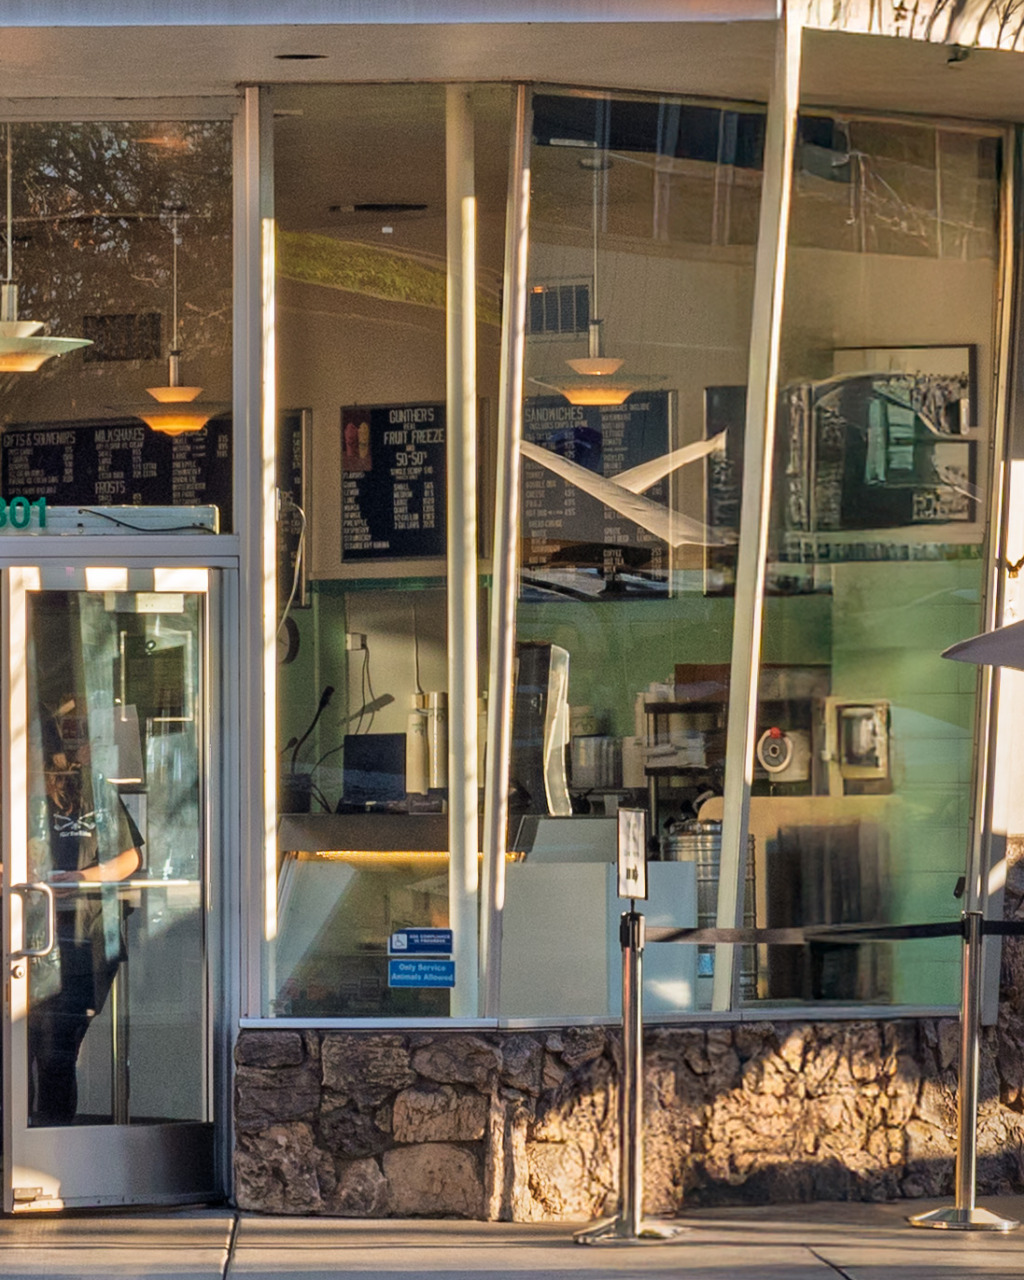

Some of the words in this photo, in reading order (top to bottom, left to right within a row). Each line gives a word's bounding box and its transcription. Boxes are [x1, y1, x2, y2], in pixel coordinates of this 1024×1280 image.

[525, 406, 584, 421] SANDWICHES
[94, 428, 145, 442] MILKSHAKES
[384, 430, 408, 445] FRUIT
[411, 428, 444, 444] FREEZE
[95, 480, 126, 495] FROSTS
[399, 963, 416, 972] Only
[418, 963, 446, 971] Service
[391, 973, 422, 981] Animals
[424, 973, 454, 981] Allowed
